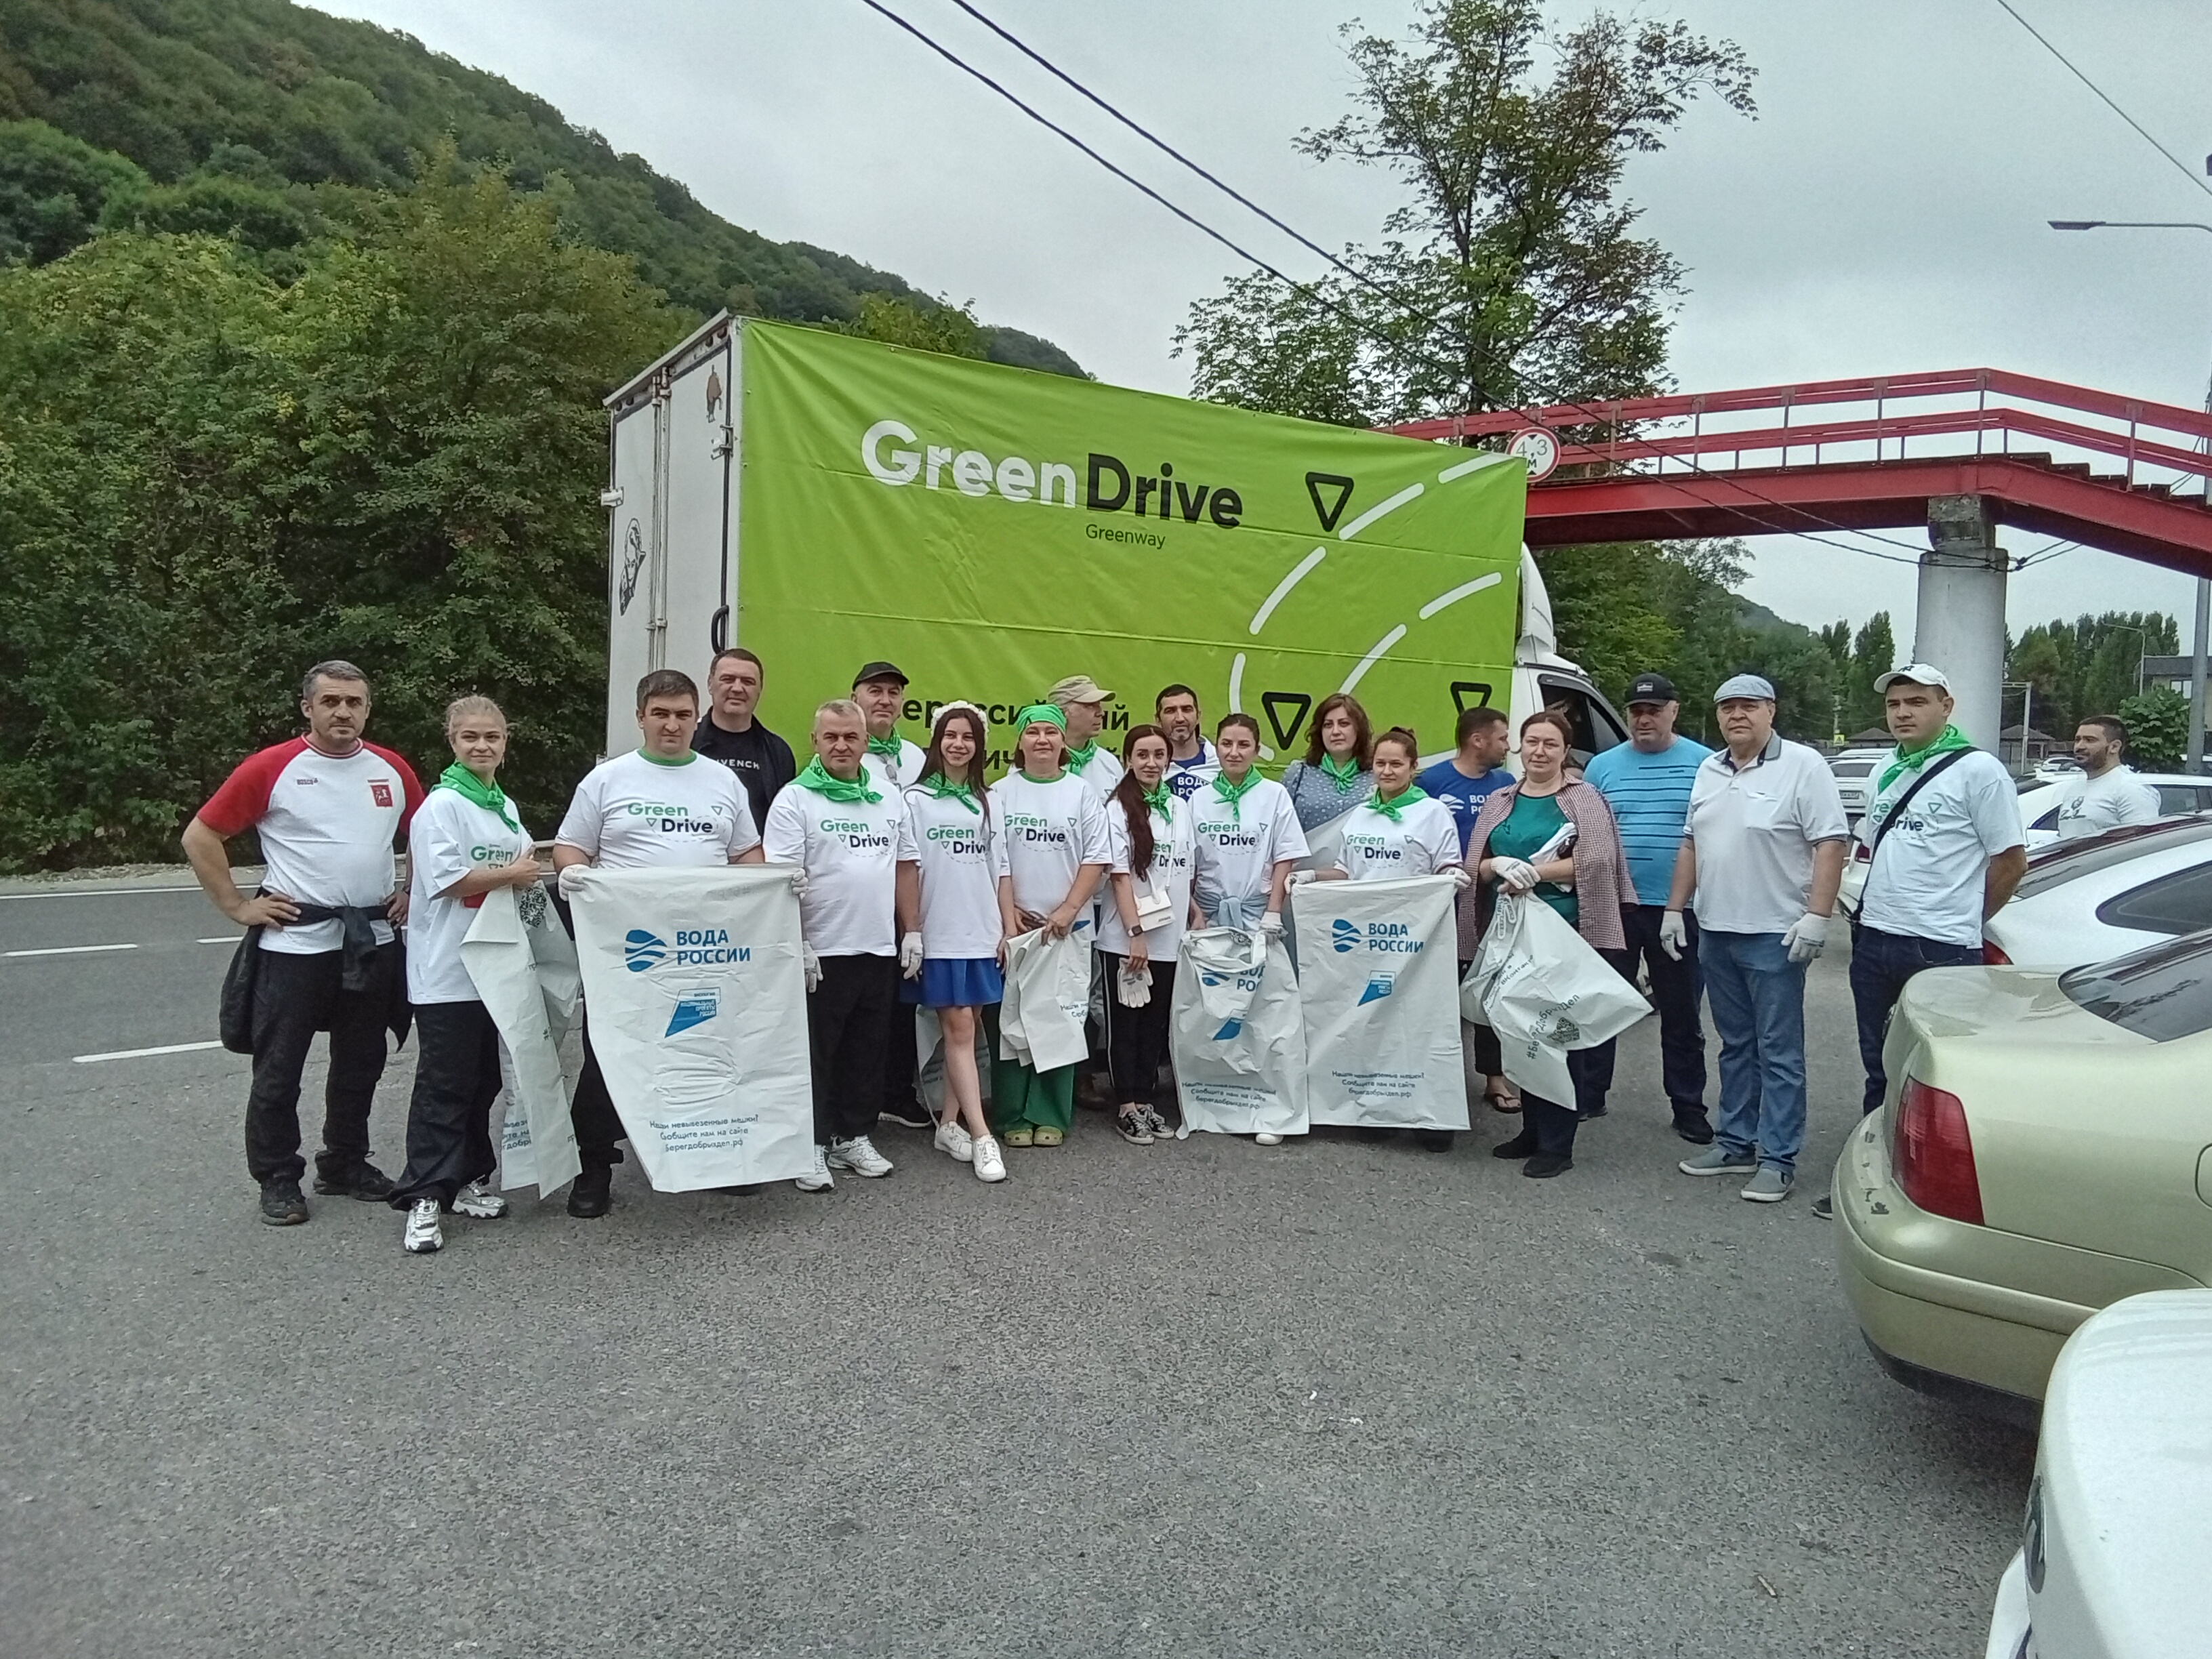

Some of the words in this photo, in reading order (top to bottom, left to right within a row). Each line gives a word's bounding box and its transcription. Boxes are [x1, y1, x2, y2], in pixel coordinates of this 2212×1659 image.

[1086, 523, 1166, 549] Greenway
[628, 802, 689, 816] Green
[661, 819, 713, 832] Drive
[820, 819, 869, 832] Green
[1004, 815, 1047, 827] Green
[1197, 822, 1240, 834] Green
[926, 827, 975, 840] Green
[1026, 828, 1065, 842] Drive
[1220, 834, 1255, 846] Drive
[1347, 834, 1385, 845] Green
[849, 834, 888, 848] Drive
[954, 840, 986, 854] Driv
[1364, 846, 1401, 860] Drive
[1159, 855, 1186, 867] Drve
[1368, 923, 1408, 938] ВОДА
[676, 929, 729, 947] ВОДА
[1369, 939, 1424, 953] РОССИИ
[677, 947, 750, 965] РОССИИ
